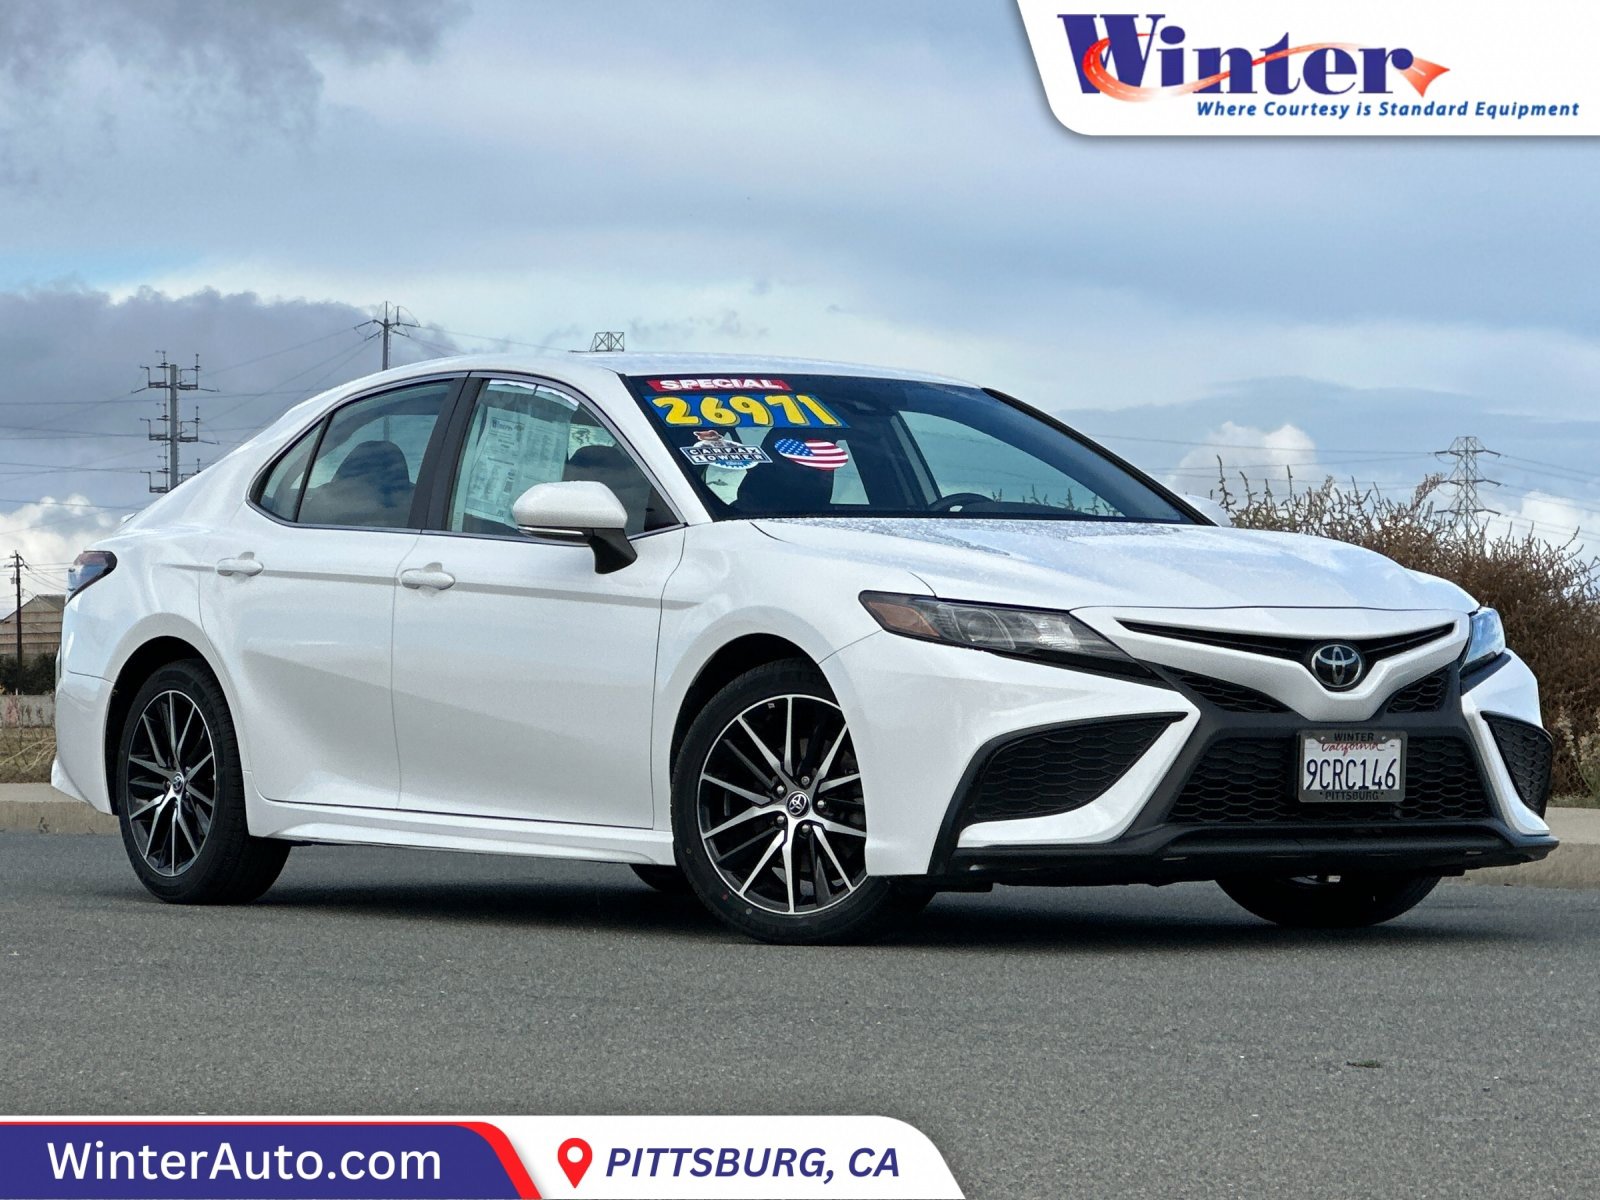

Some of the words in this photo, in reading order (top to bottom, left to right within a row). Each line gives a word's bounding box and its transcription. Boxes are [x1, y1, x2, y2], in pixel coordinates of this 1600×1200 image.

[659, 378, 783, 391] SPECIAL
[652, 394, 842, 426] 26971
[689, 447, 762, 455] CARFAX
[1333, 732, 1375, 741] WINTER
[1306, 758, 1398, 790] 9CRC146
[1324, 791, 1379, 801] PITTSBURG
